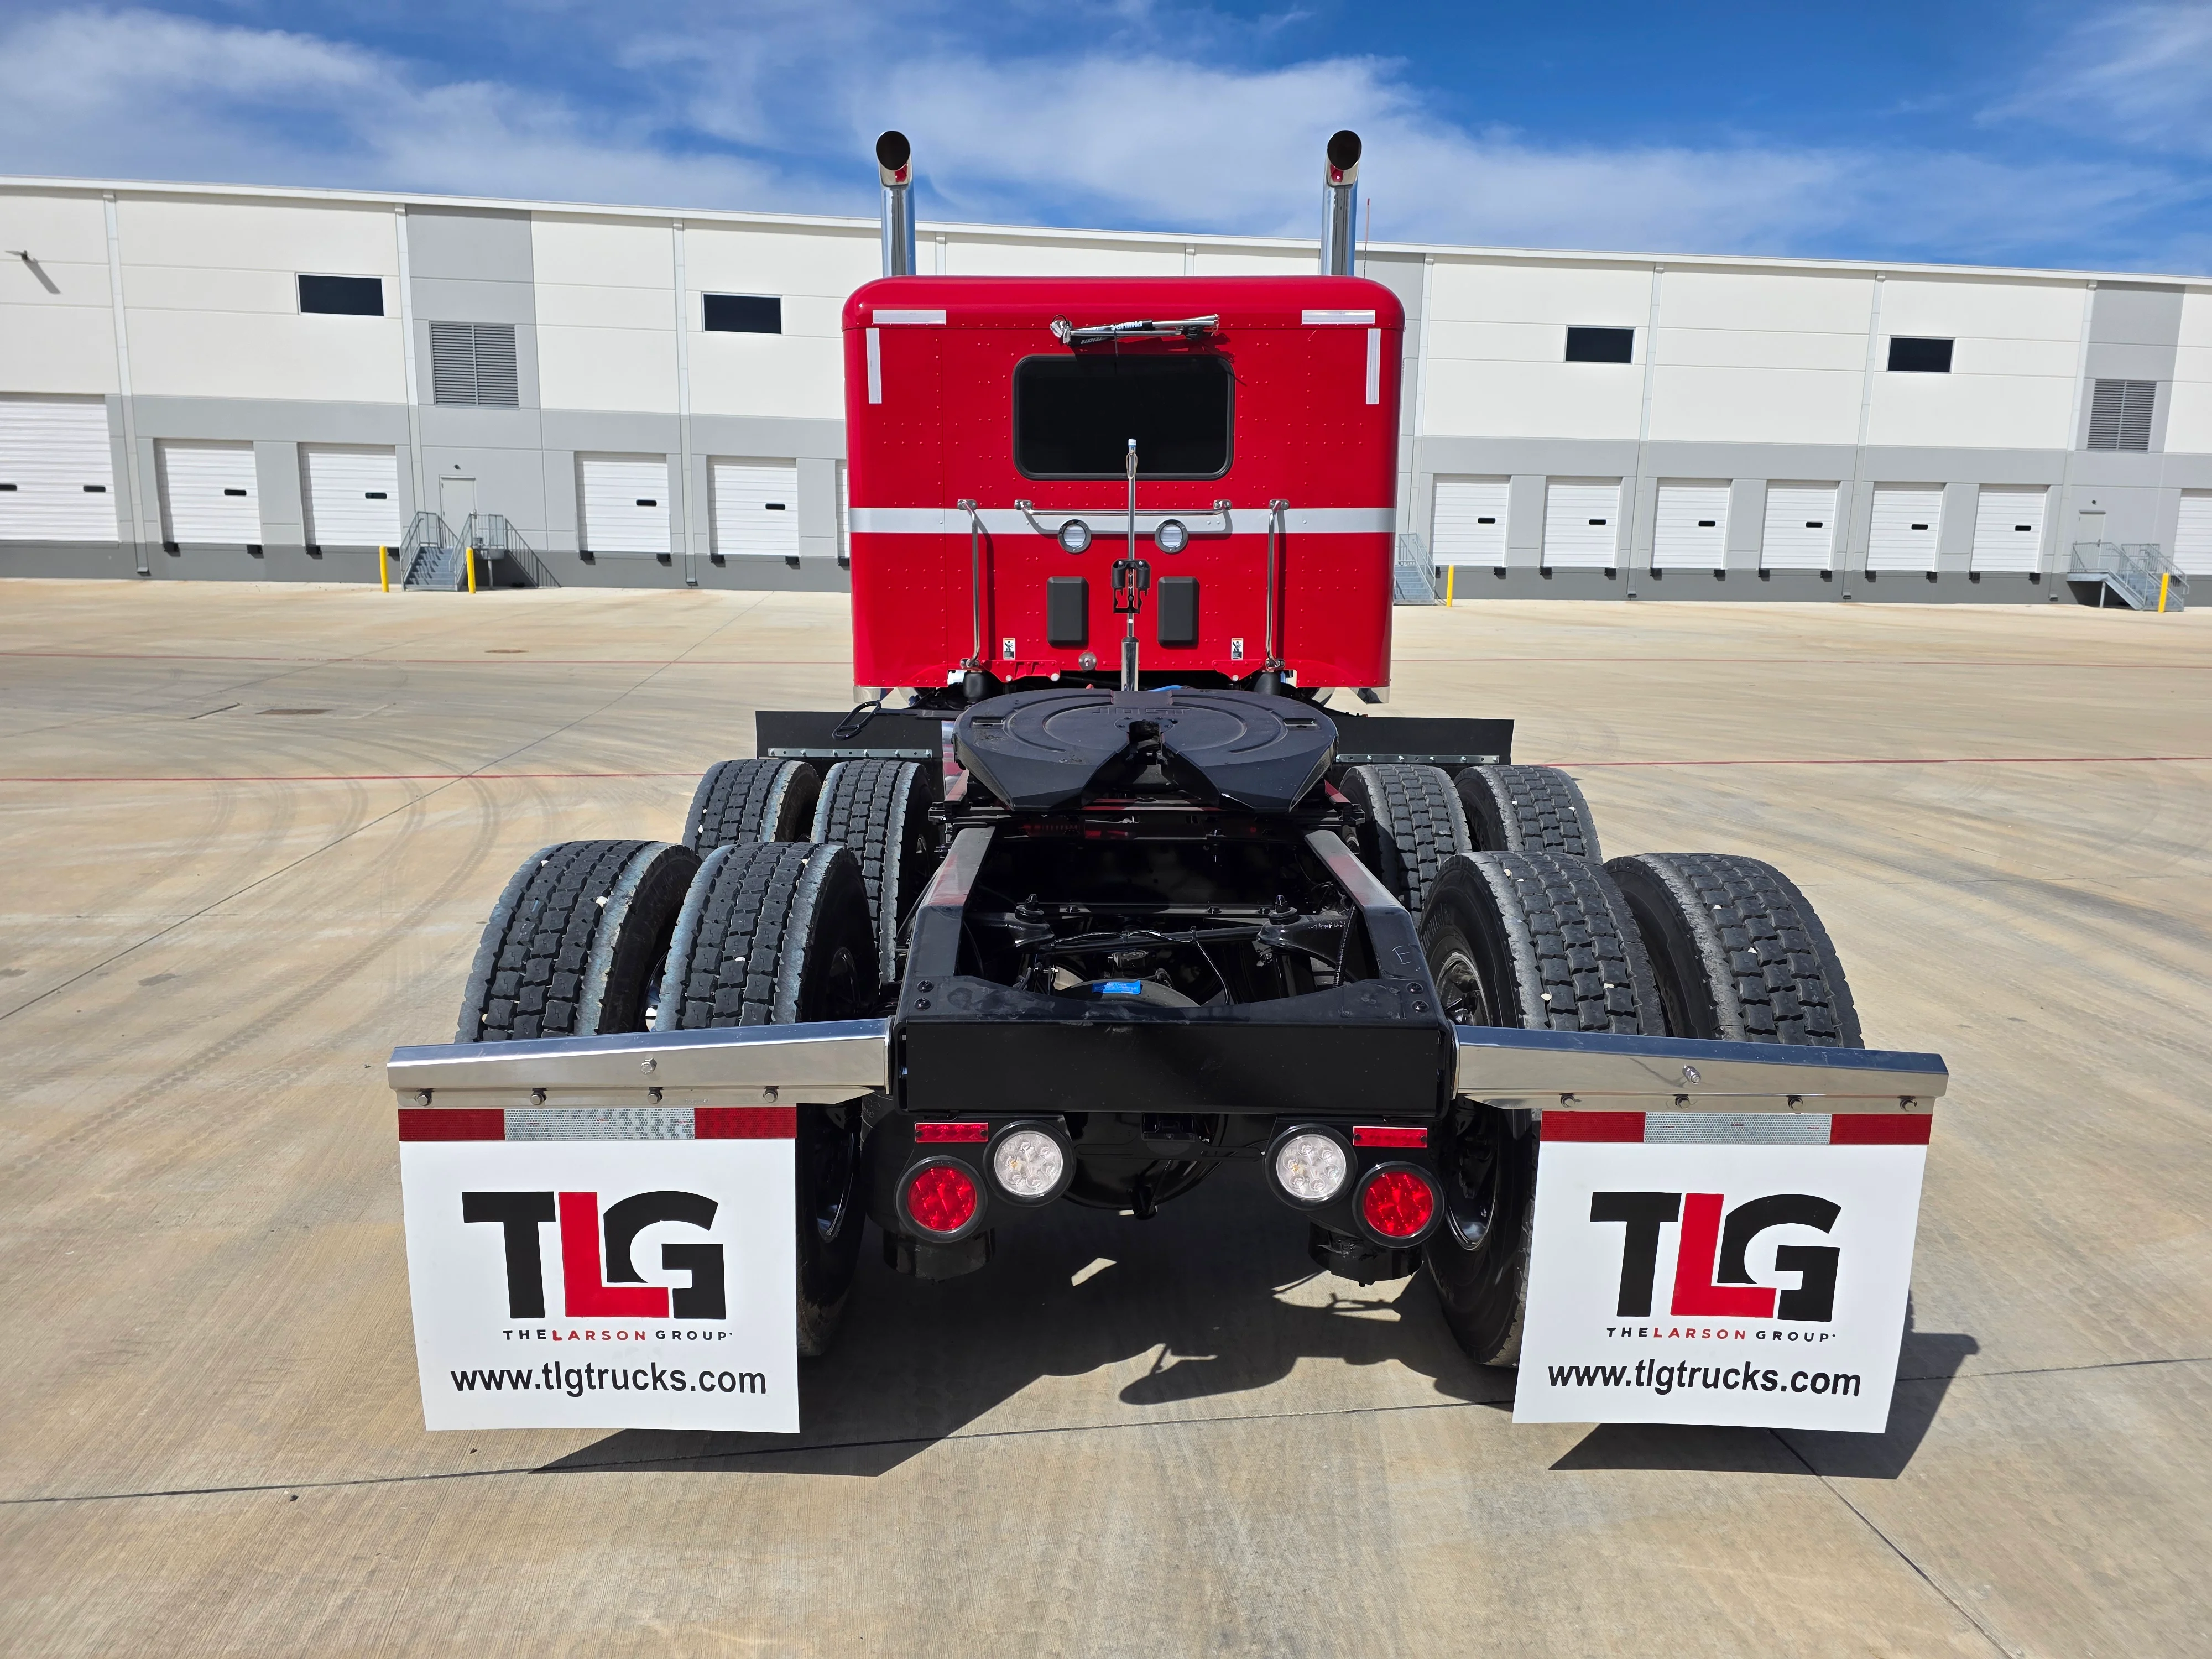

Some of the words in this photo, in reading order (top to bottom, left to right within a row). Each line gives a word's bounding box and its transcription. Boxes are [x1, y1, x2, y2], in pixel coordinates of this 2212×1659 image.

[461, 1191, 727, 1321] TLG
[1590, 1191, 1842, 1322] TLG
[655, 1329, 727, 1342] GROUP
[1756, 1329, 1829, 1343] GROUP
[450, 1361, 766, 1397] www.tlgtrucks.com
[1548, 1358, 1861, 1397] www.tlgtrucks.com
